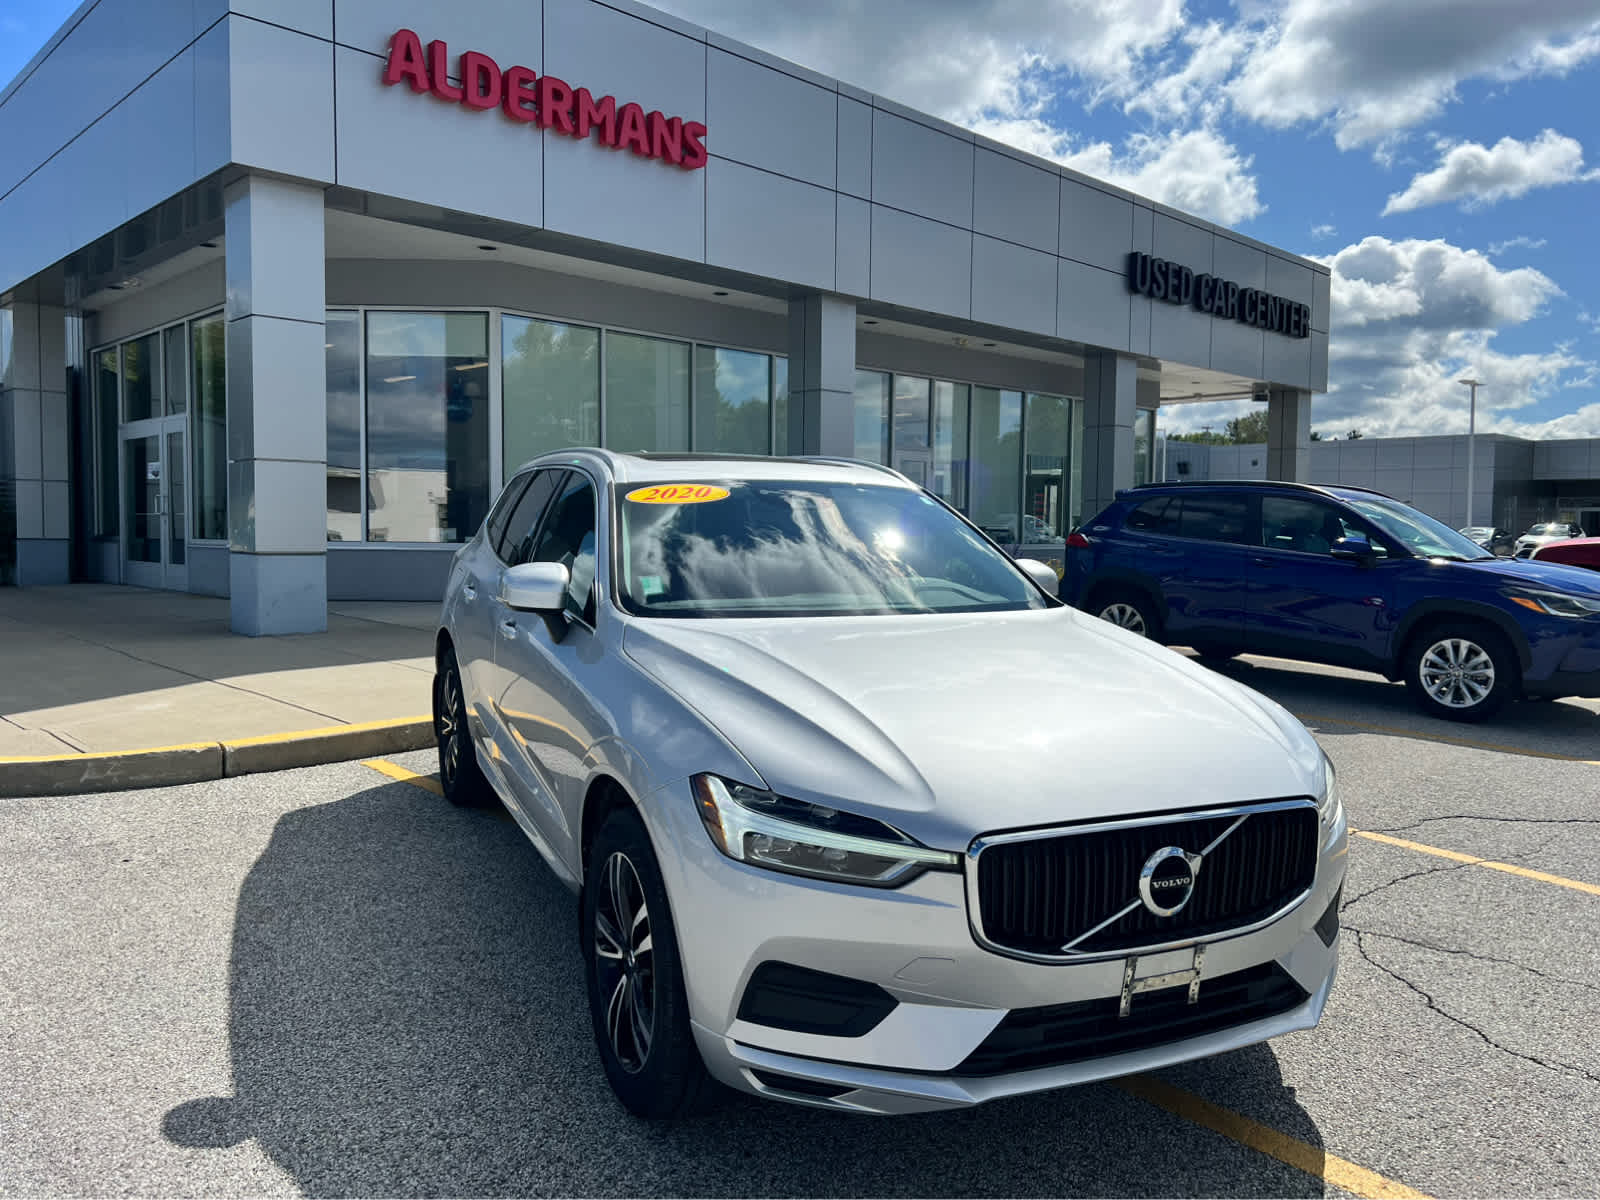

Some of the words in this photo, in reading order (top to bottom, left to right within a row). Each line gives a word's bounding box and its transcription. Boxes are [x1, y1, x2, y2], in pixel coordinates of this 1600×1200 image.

[383, 29, 708, 171] ALDERMANS
[1129, 251, 1195, 305] USED
[1194, 272, 1240, 319] CAR
[1237, 287, 1311, 338] CENTER
[643, 487, 712, 500] 2020
[1152, 877, 1191, 889] VOLVO
